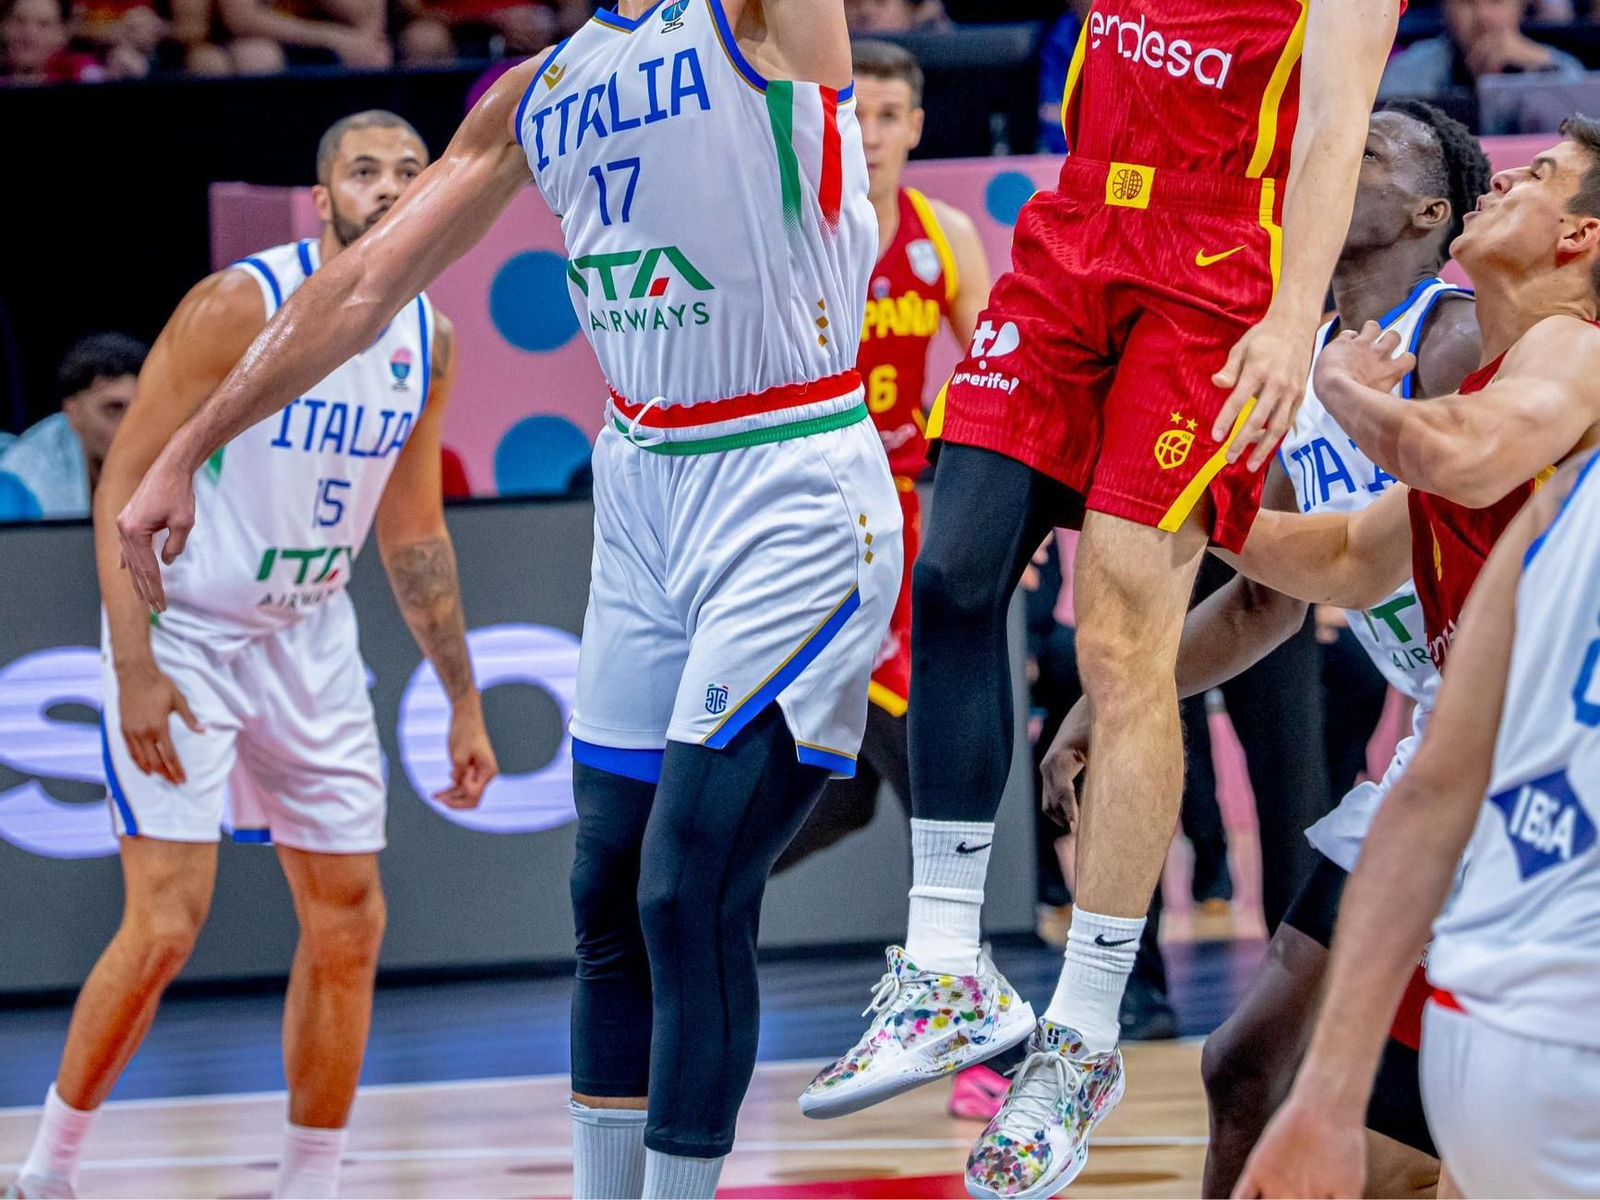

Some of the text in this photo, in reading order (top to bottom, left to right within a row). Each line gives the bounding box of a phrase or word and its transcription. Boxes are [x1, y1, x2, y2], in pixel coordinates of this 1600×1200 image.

[1090, 11, 1233, 89] endesa
[532, 47, 711, 172] ITALIA
[588, 157, 641, 226] 17
[567, 246, 716, 301] ITA
[590, 302, 710, 333] AIRWAYS
[861, 290, 940, 342] PAÑA
[868, 364, 898, 413] 6
[271, 398, 412, 458] ITALIA
[1362, 593, 1418, 644] IT
